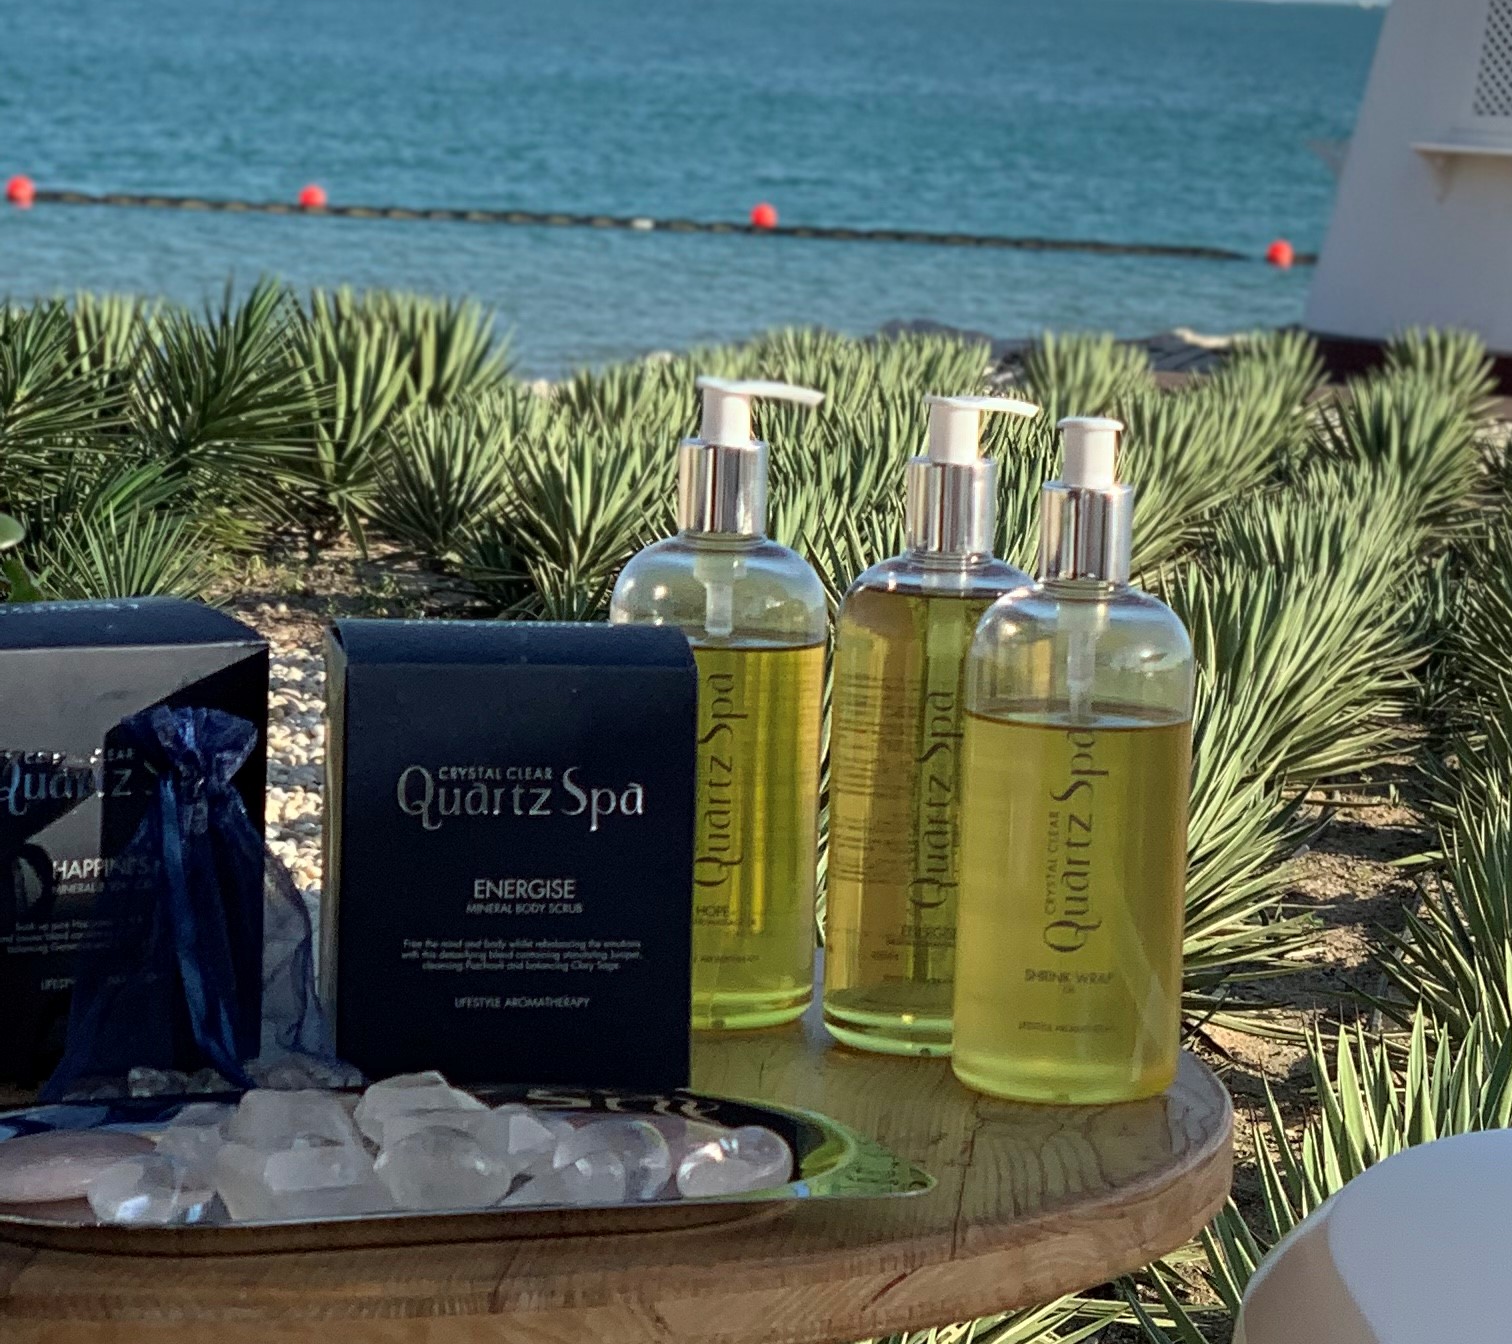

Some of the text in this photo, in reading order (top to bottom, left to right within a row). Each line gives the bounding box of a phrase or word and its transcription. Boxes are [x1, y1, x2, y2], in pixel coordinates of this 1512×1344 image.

[697, 673, 749, 745] Spa
[915, 691, 964, 763] Spa
[397, 765, 644, 832] Quartz Spa
[438, 766, 553, 781] CRYSTAL CLEAR
[694, 755, 743, 887] Quartz
[908, 775, 959, 908] Quartz
[473, 878, 576, 899] ENERGISE
[1043, 813, 1102, 953] Quartz
[1044, 811, 1059, 915] CRYSTAL CLEAR
[515, 902, 546, 915] BODY
[548, 902, 583, 915] SCRUB
